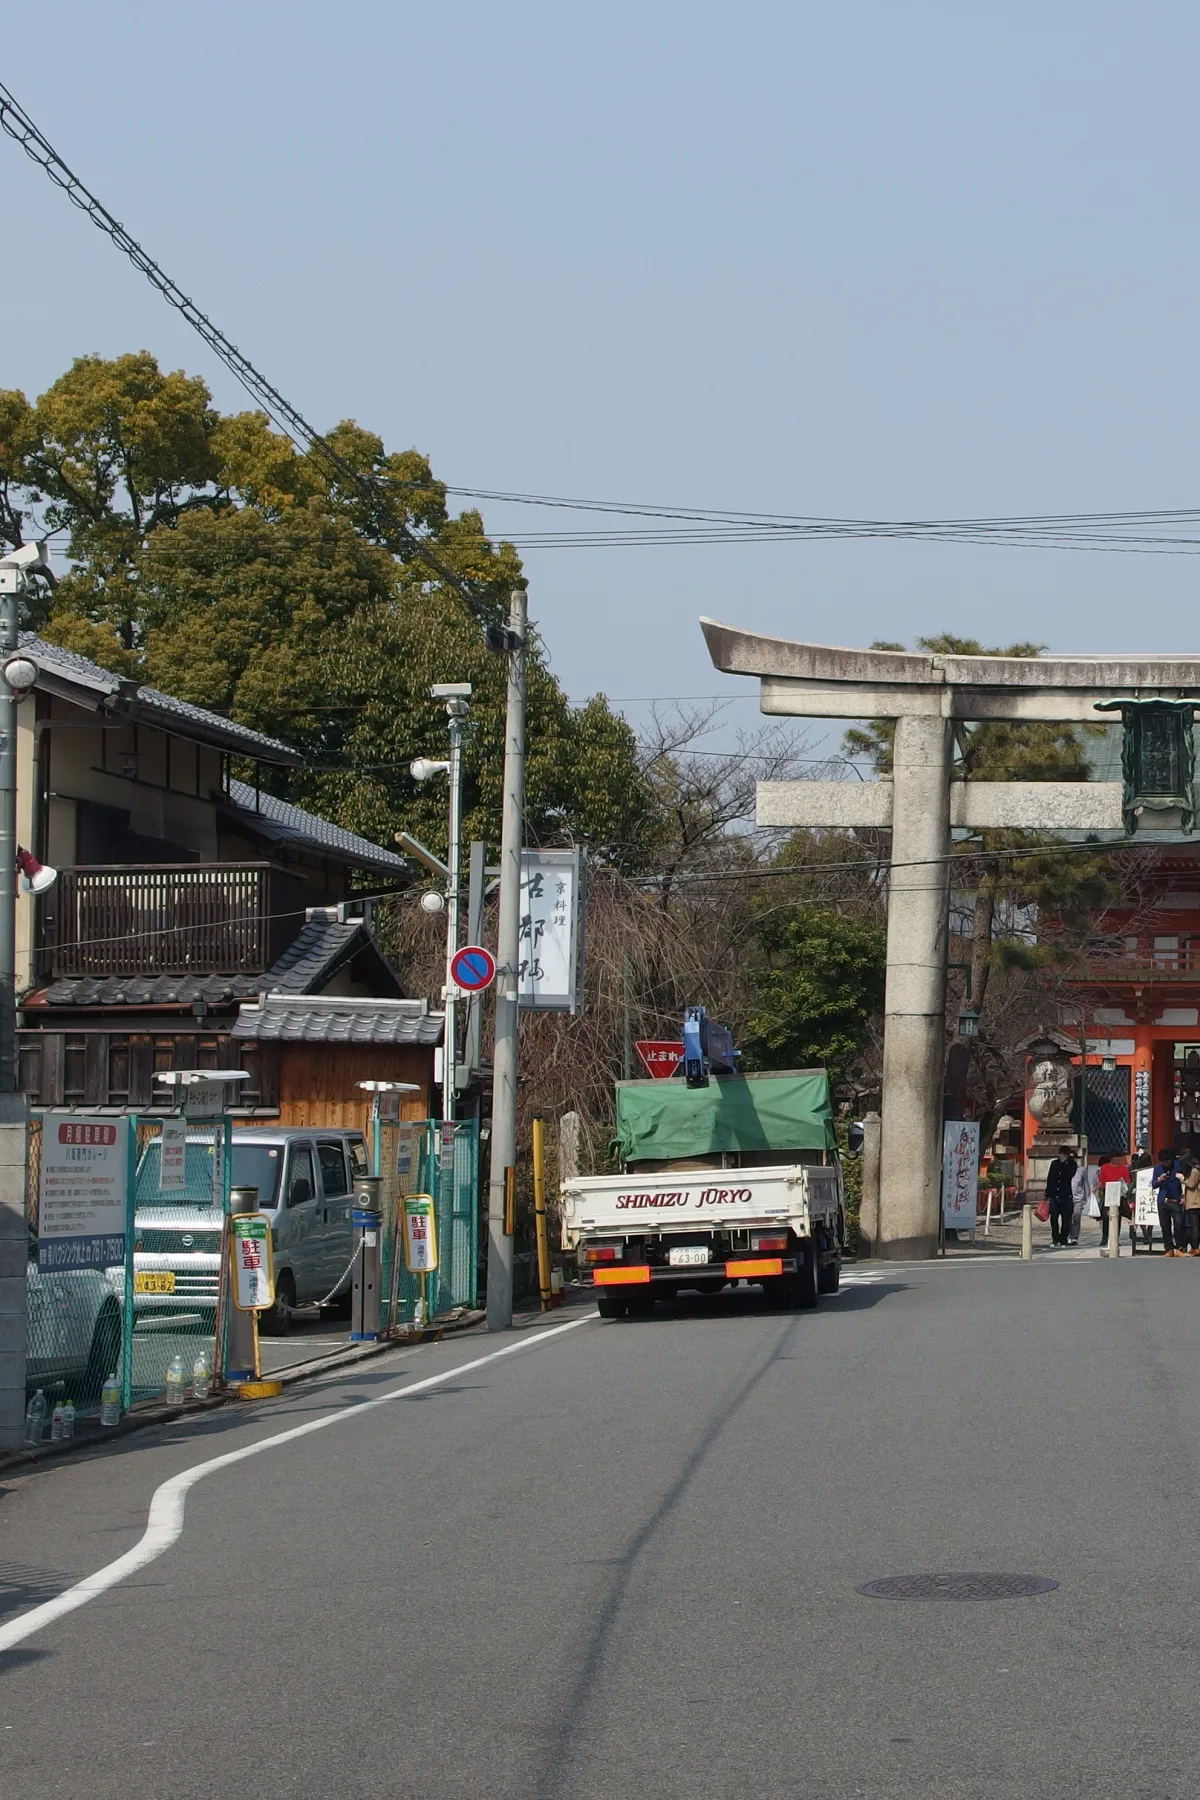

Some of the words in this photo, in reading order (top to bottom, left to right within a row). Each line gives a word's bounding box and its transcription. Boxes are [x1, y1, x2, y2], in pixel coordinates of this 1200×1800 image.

[553, 881, 567, 926] 京料理
[647, 1050, 679, 1062] 止まれ
[616, 1192, 690, 1210] SHIMIZU
[679, 1253, 706, 1264] 63-00
